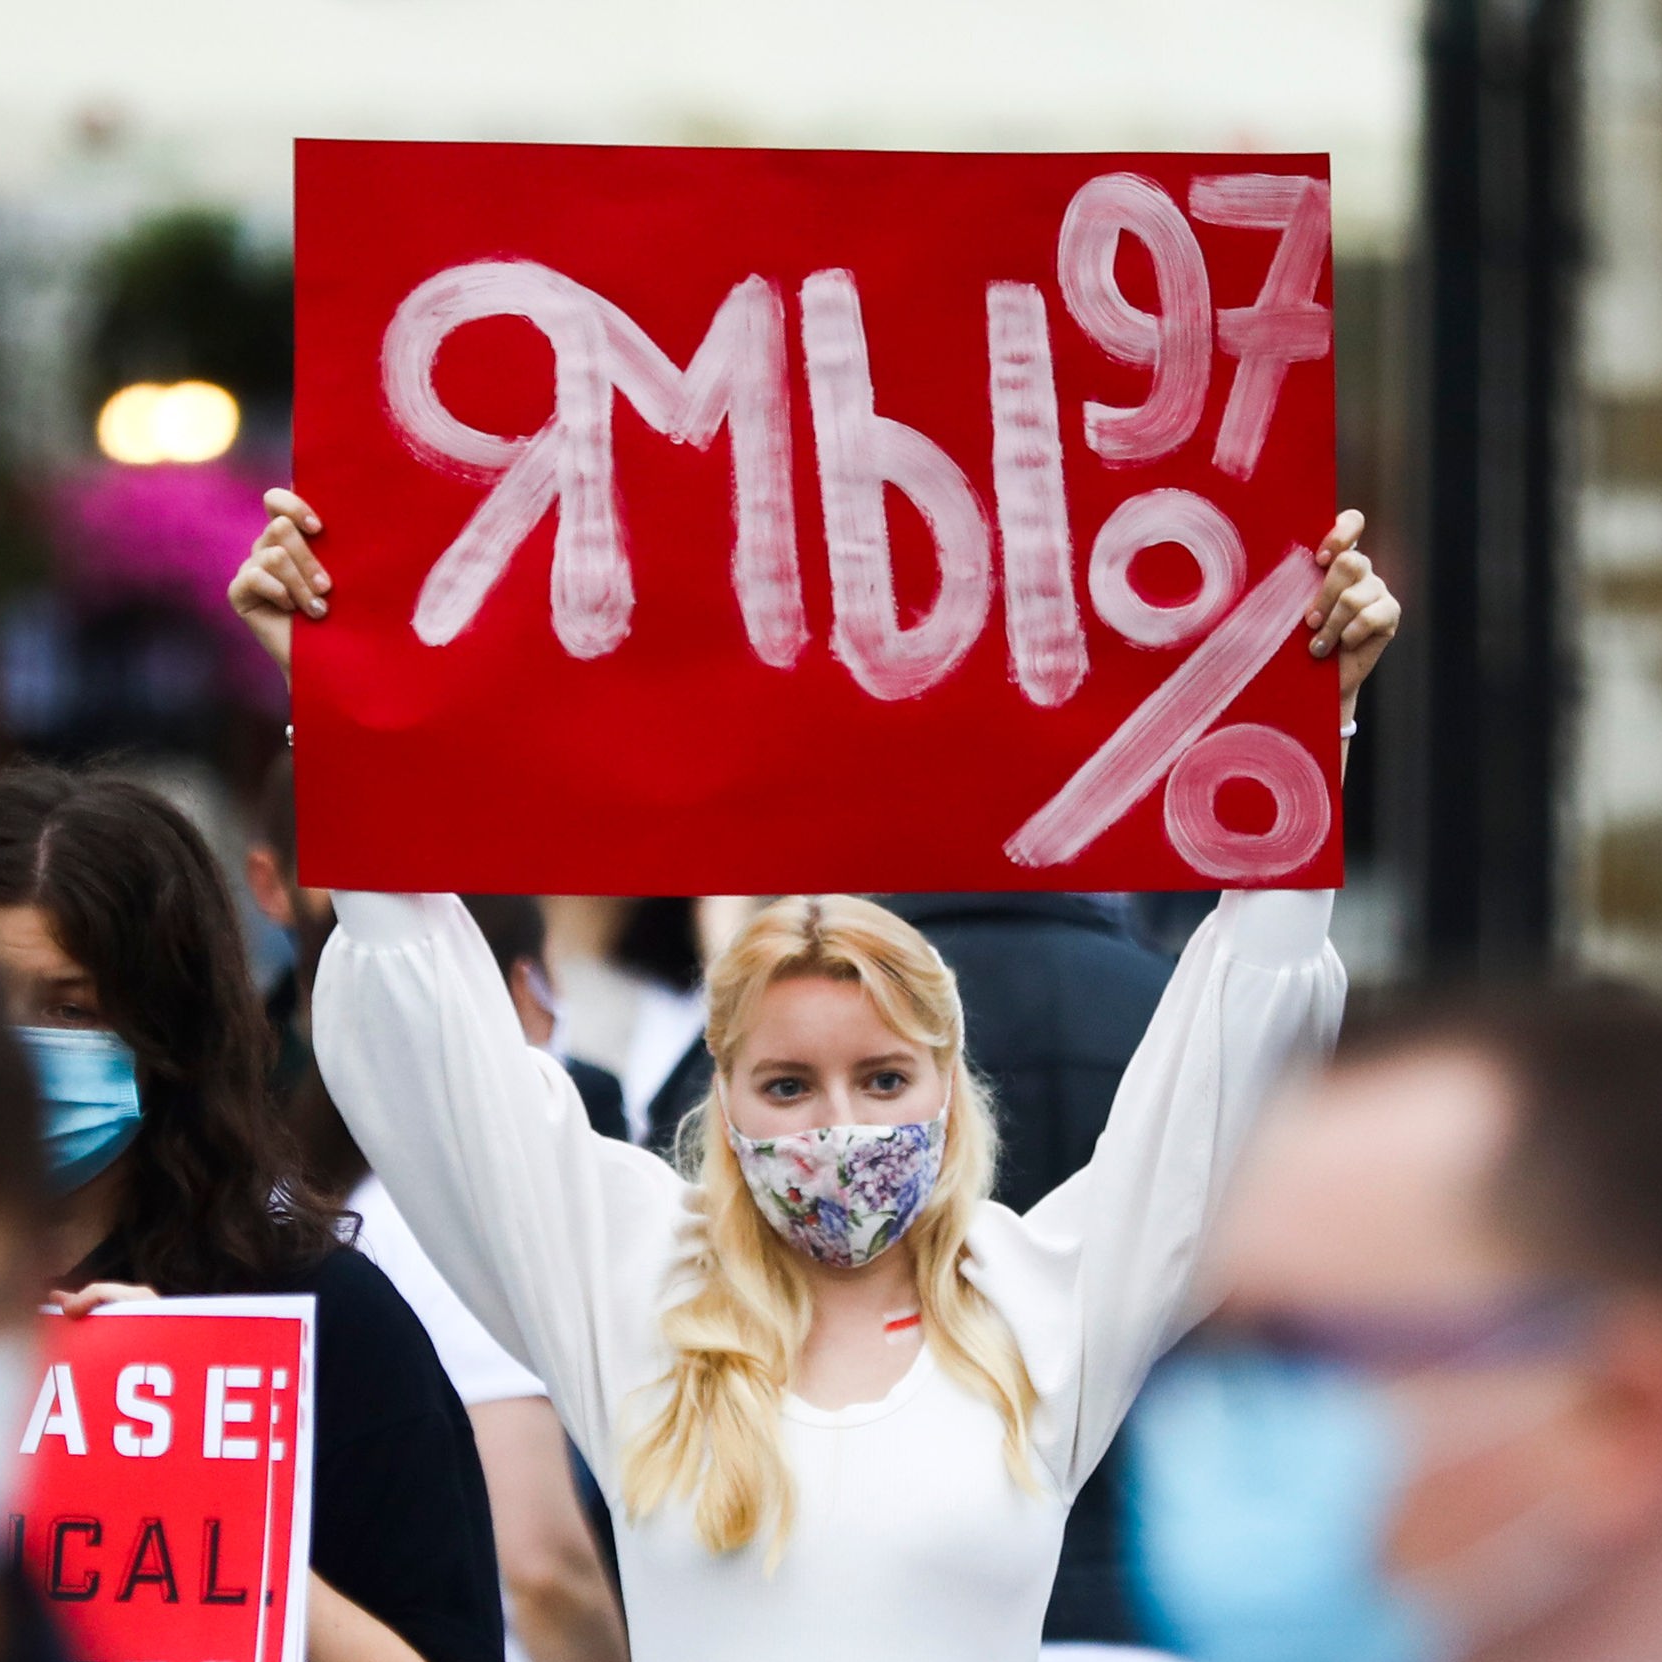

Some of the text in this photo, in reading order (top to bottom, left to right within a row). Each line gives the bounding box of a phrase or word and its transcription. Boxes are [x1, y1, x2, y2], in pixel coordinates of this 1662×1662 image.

[1057, 172, 1332, 480] 97
[1002, 488, 1332, 881] %
[19, 1364, 261, 1460] ASE
[9, 1514, 247, 1606] ICAL
